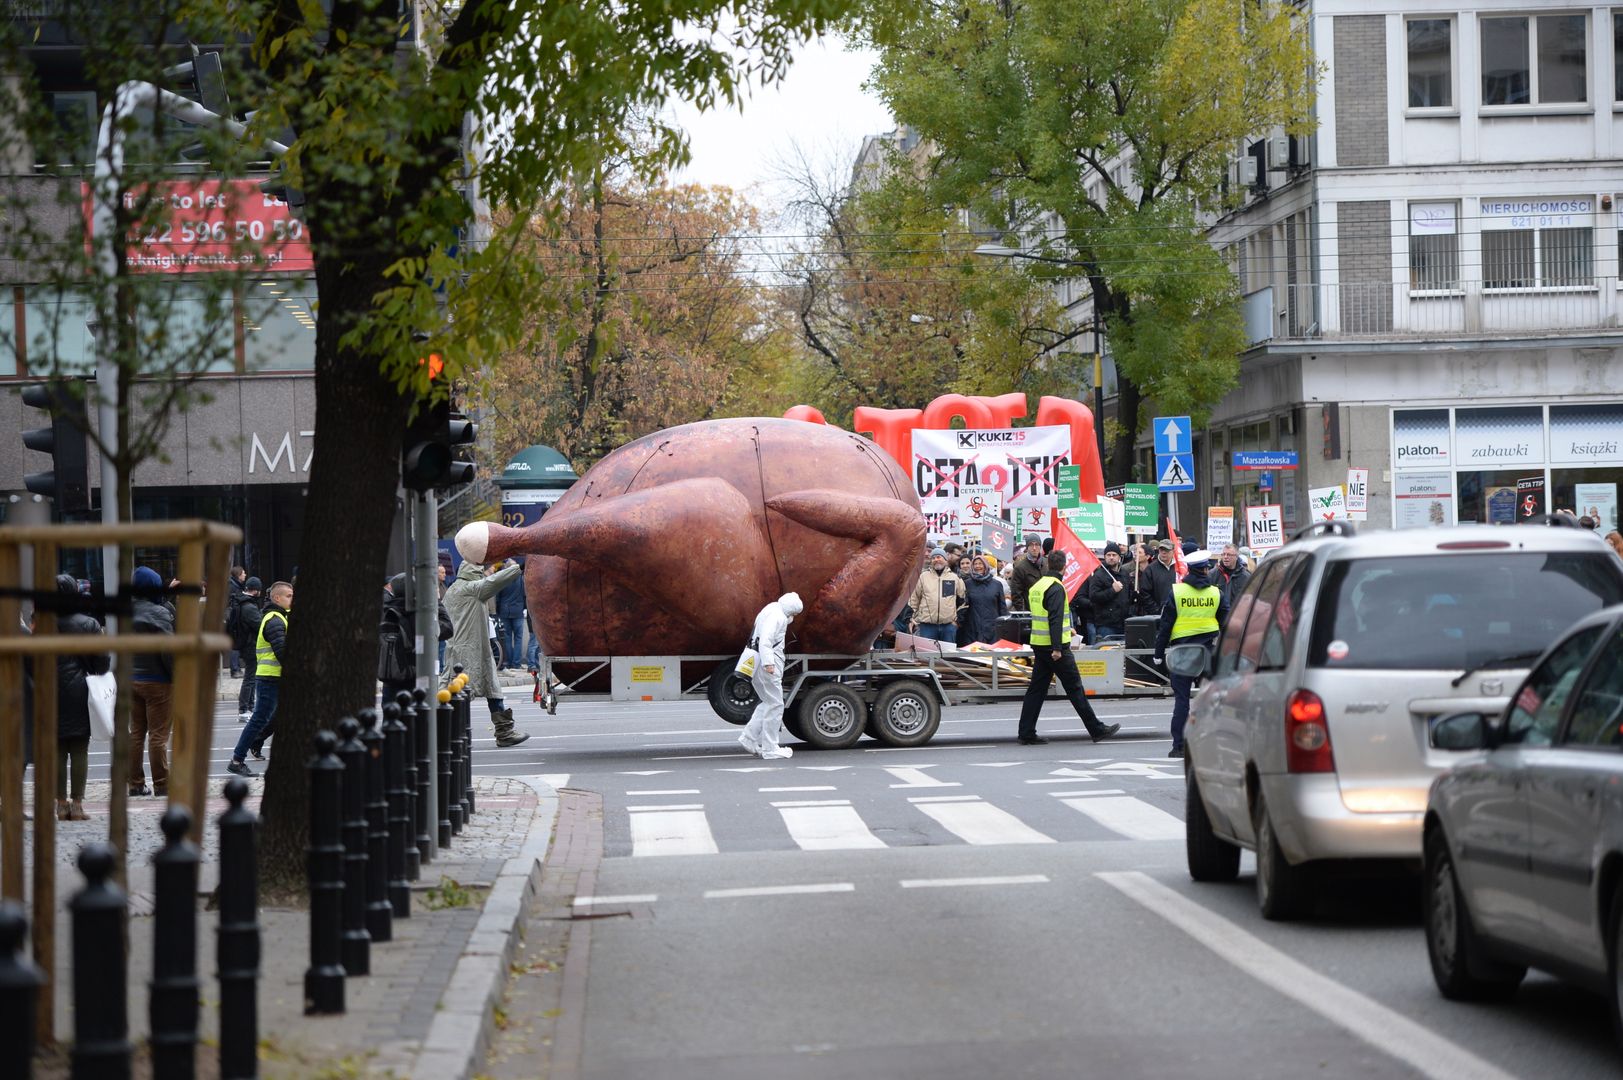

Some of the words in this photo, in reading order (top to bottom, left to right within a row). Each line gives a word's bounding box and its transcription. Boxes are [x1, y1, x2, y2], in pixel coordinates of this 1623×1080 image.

[200, 190, 226, 209] let
[1481, 199, 1592, 214] NIERUCHOMOŚCI
[1511, 216, 1532, 227] 621
[1540, 215, 1553, 226] 01
[1558, 215, 1572, 226] 11
[181, 221, 227, 243] 596
[235, 219, 265, 242] 50
[272, 218, 303, 241] 50
[1397, 444, 1439, 460] platon
[1471, 443, 1529, 458] zabawki
[1571, 441, 1618, 457] książki
[1242, 456, 1291, 465] Marszałkowska
[916, 457, 979, 498] CETA
[1350, 482, 1365, 496] NIE
[1252, 519, 1279, 534] NIE
[1253, 537, 1280, 545] UMOWY
[1181, 597, 1215, 608] POLICJA
